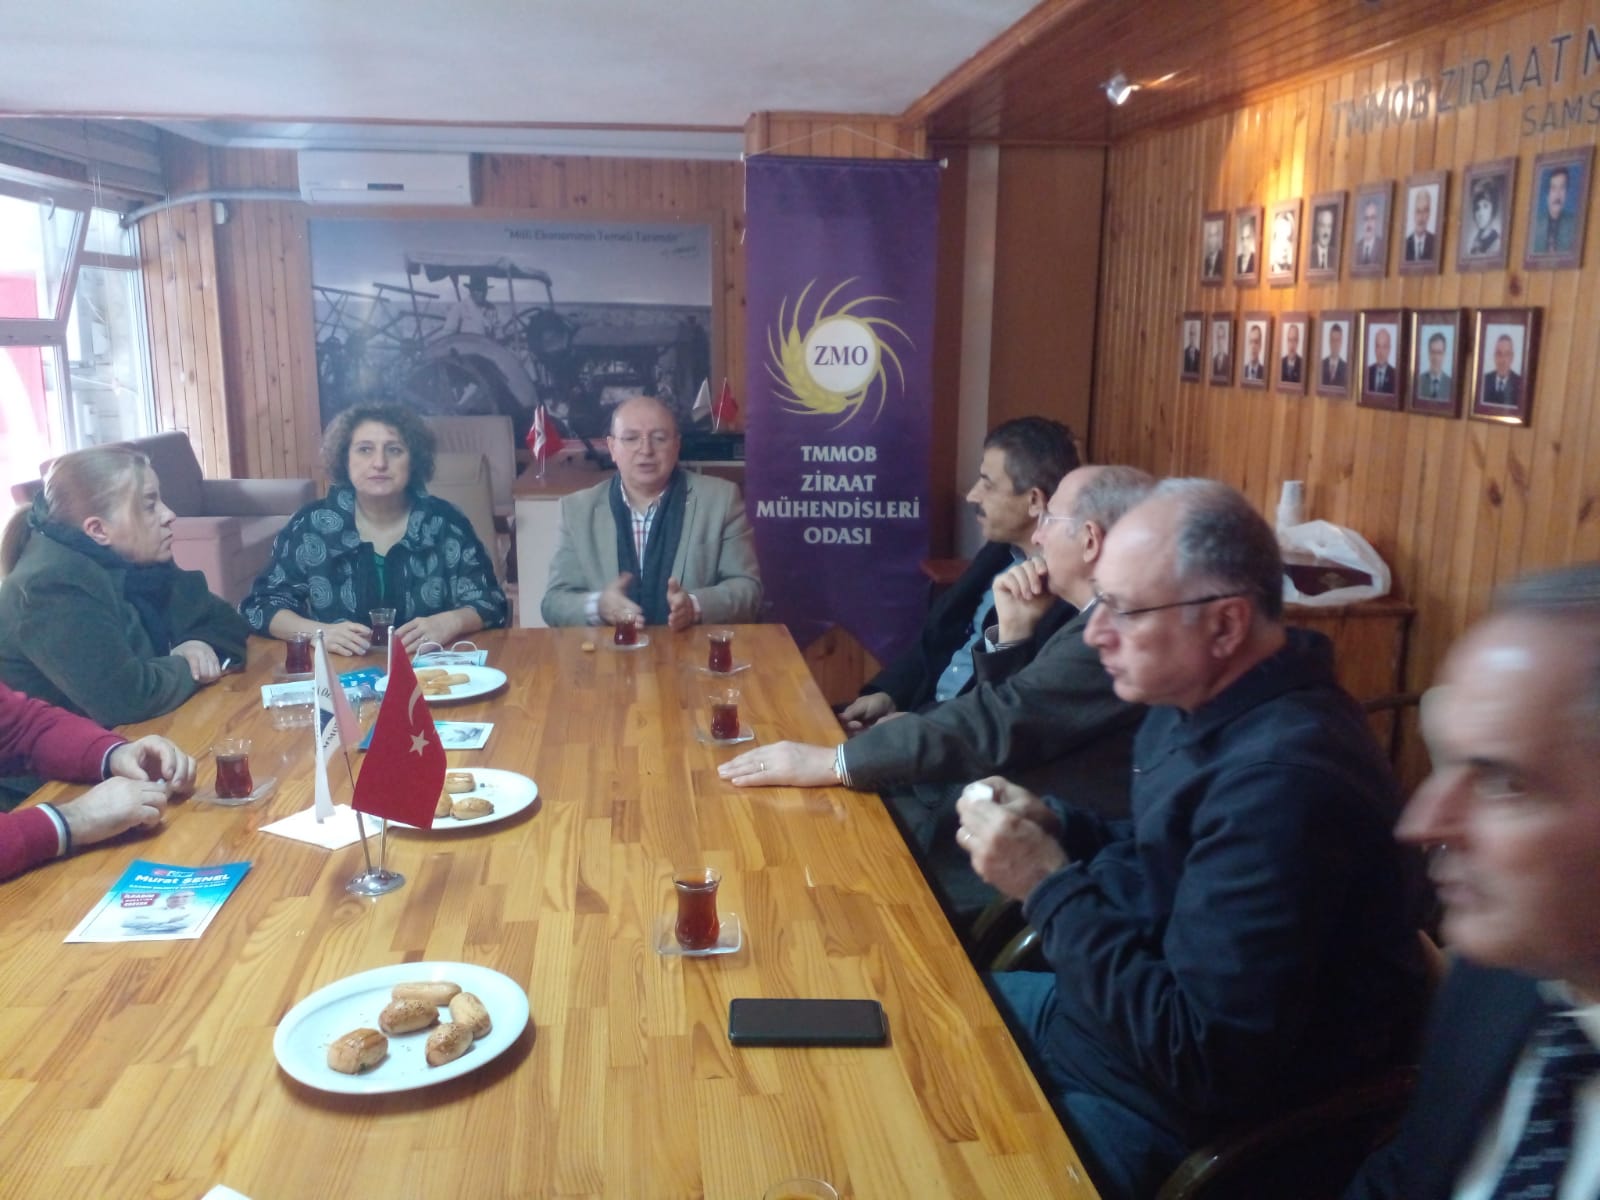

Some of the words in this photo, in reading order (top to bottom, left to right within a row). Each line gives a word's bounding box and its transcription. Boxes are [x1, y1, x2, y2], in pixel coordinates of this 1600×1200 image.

[1333, 77, 1431, 138] TMMOB
[813, 345, 868, 366] ZMO
[801, 446, 877, 462] TMMOB
[801, 470, 876, 492] ZİRAAT
[756, 496, 920, 519] MÜHENDİSLERİ
[804, 527, 872, 545] ODASI
